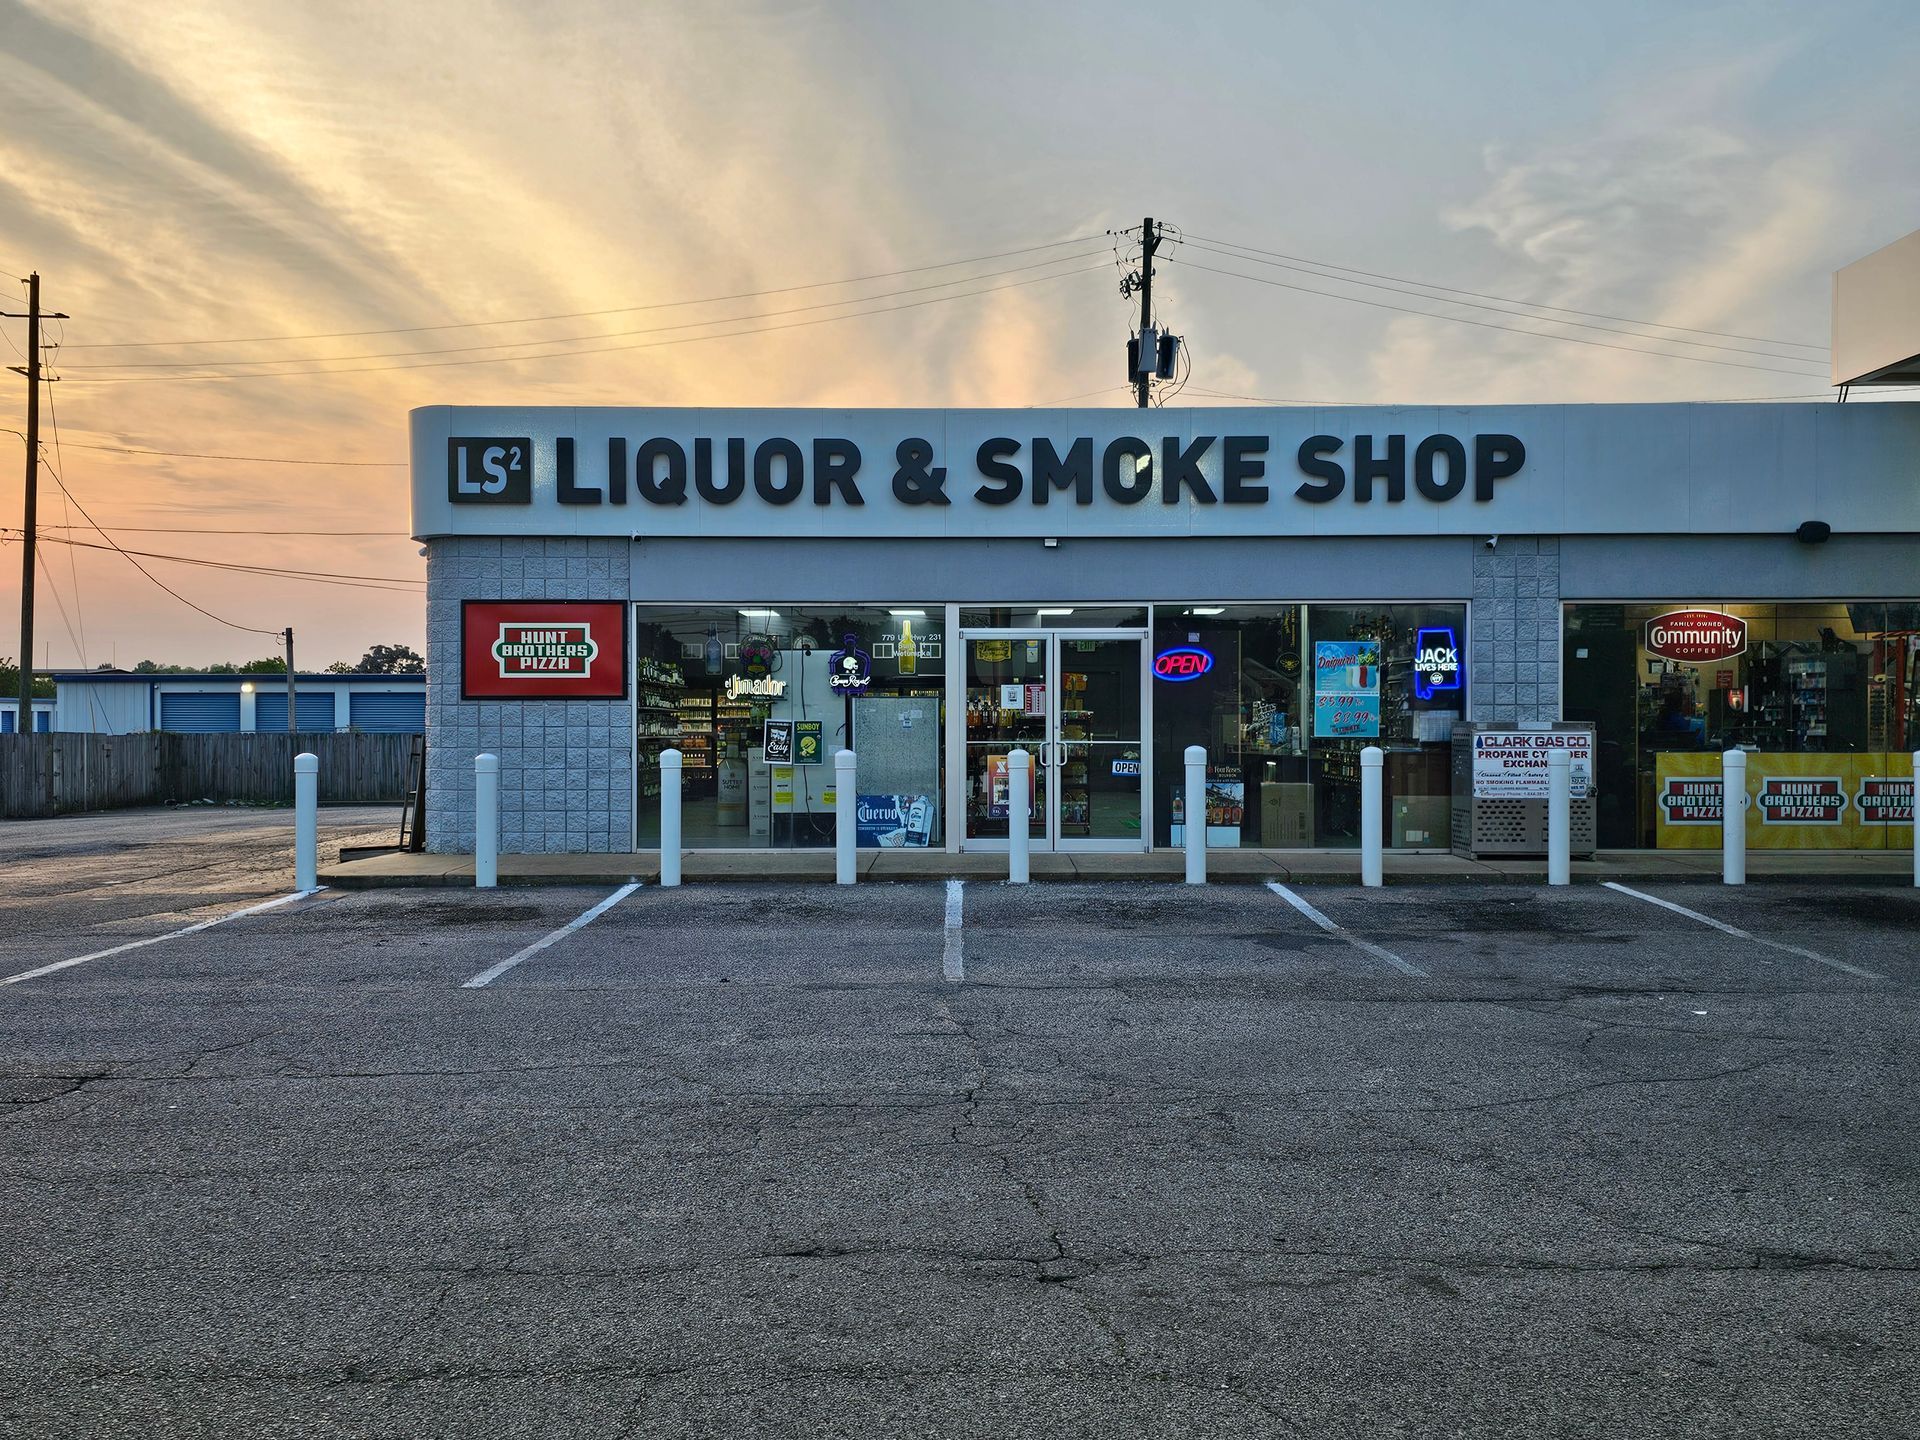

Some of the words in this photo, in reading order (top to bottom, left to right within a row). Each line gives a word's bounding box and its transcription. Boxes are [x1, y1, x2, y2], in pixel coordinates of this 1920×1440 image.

[556, 437, 865, 505] LIQUOR
[892, 437, 952, 505] &
[973, 436, 1269, 505] SMOKE
[1294, 434, 1526, 503] SHOP
[521, 631, 568, 644] HUNT
[1650, 626, 1742, 648] Community
[502, 645, 588, 656] BROTHERS
[1415, 647, 1457, 663] JACK
[520, 657, 570, 670] PIZZA
[1155, 655, 1207, 674] OPEN
[1415, 663, 1437, 671] LIVES
[1437, 663, 1458, 671] HERE
[767, 741, 788, 754] Easy
[1484, 737, 1532, 747] CLARK
[1534, 737, 1564, 747] GAS
[1567, 737, 1590, 747] CO.
[1115, 763, 1139, 773] OPEN
[1683, 784, 1722, 795] HUNT
[1781, 784, 1823, 795] HUNT
[1667, 796, 1722, 806] BROTHE
[1764, 796, 1840, 806] BROTHERS
[1862, 796, 1914, 806] BROTH
[858, 802, 897, 822] Cuervo
[1780, 807, 1824, 818] PIZZA
[1878, 807, 1914, 818] PIZZ
